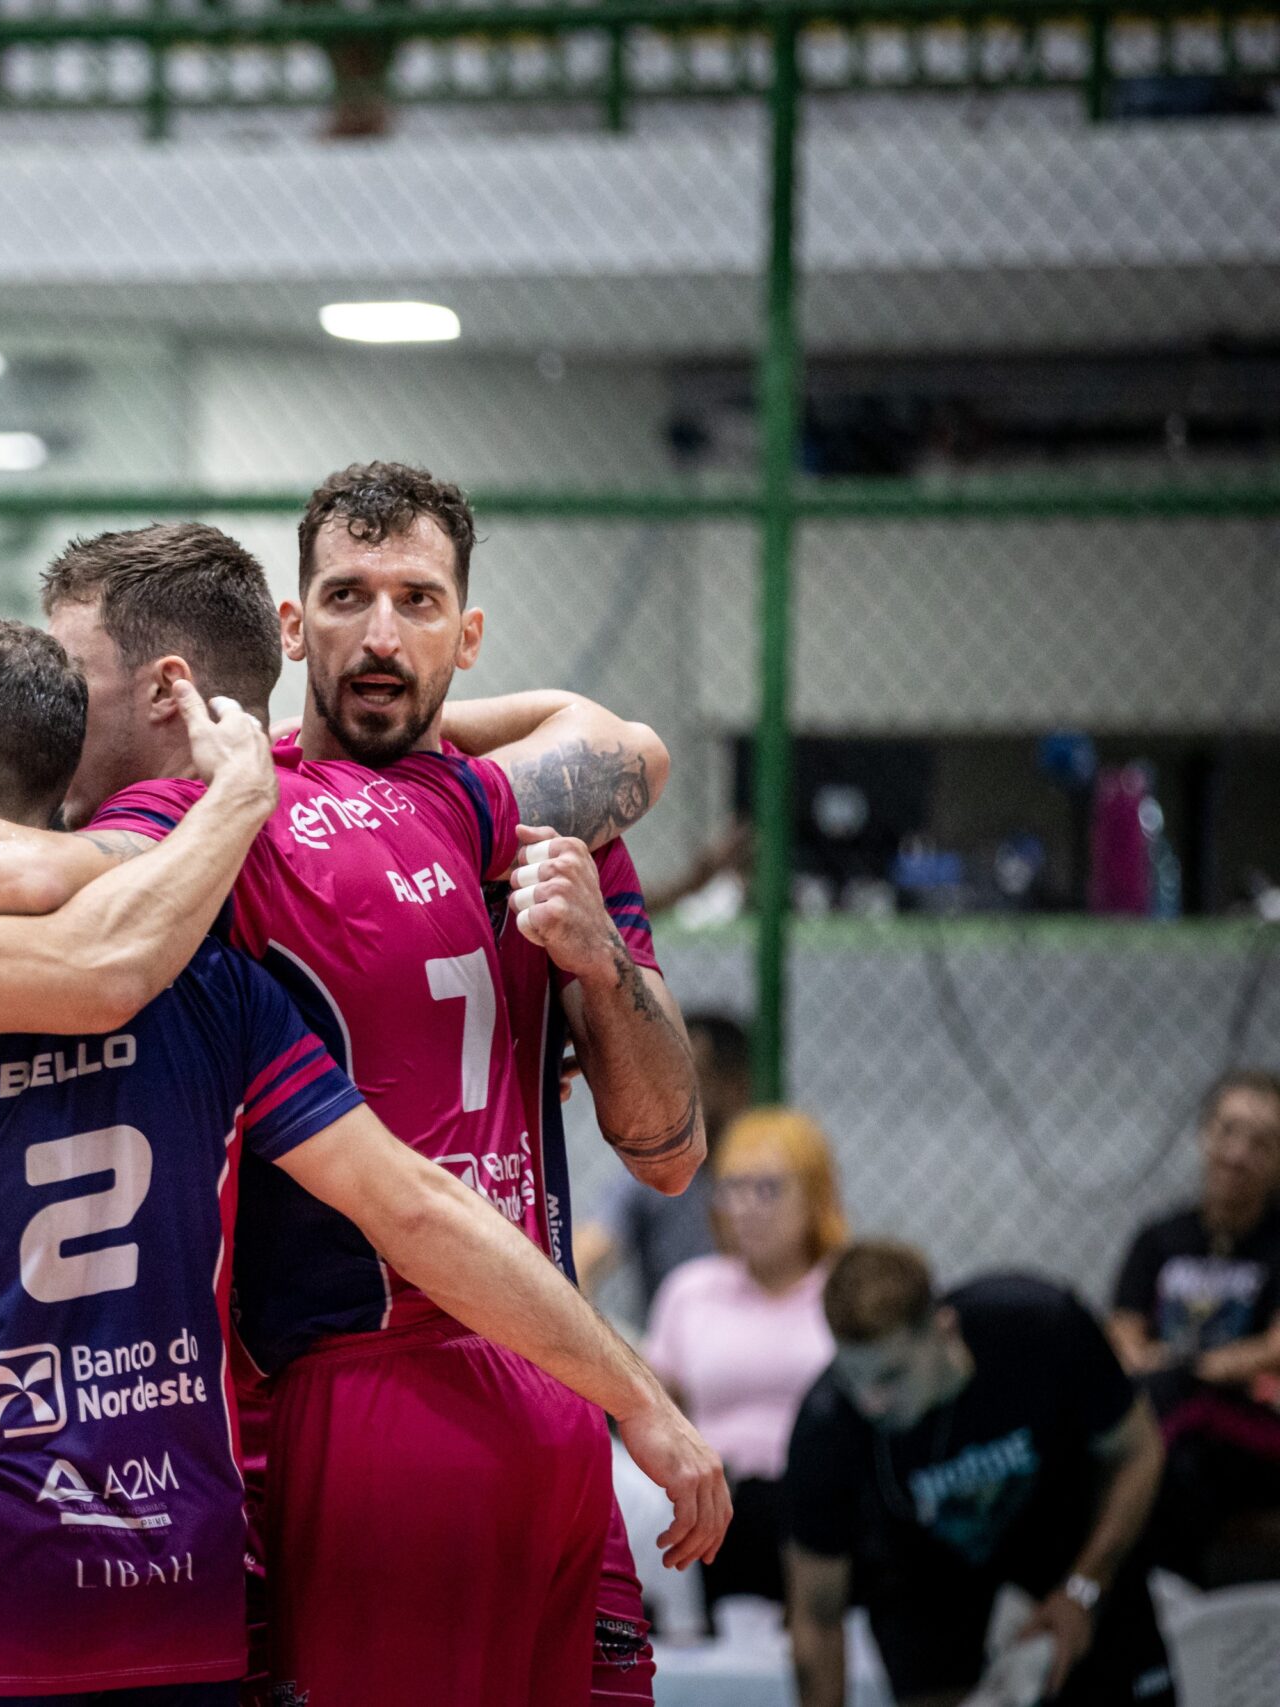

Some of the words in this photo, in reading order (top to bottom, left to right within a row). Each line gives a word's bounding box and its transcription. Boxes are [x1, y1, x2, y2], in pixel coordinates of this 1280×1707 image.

[424, 946, 497, 1113] 7
[19, 1124, 153, 1303] 2
[71, 1340, 157, 1382] Banco
[169, 1327, 199, 1365] do
[77, 1372, 207, 1423] Nordeste
[103, 1451, 180, 1500] A2M
[140, 1516, 168, 1528] PRIME
[76, 1552, 193, 1589] LIBAH
